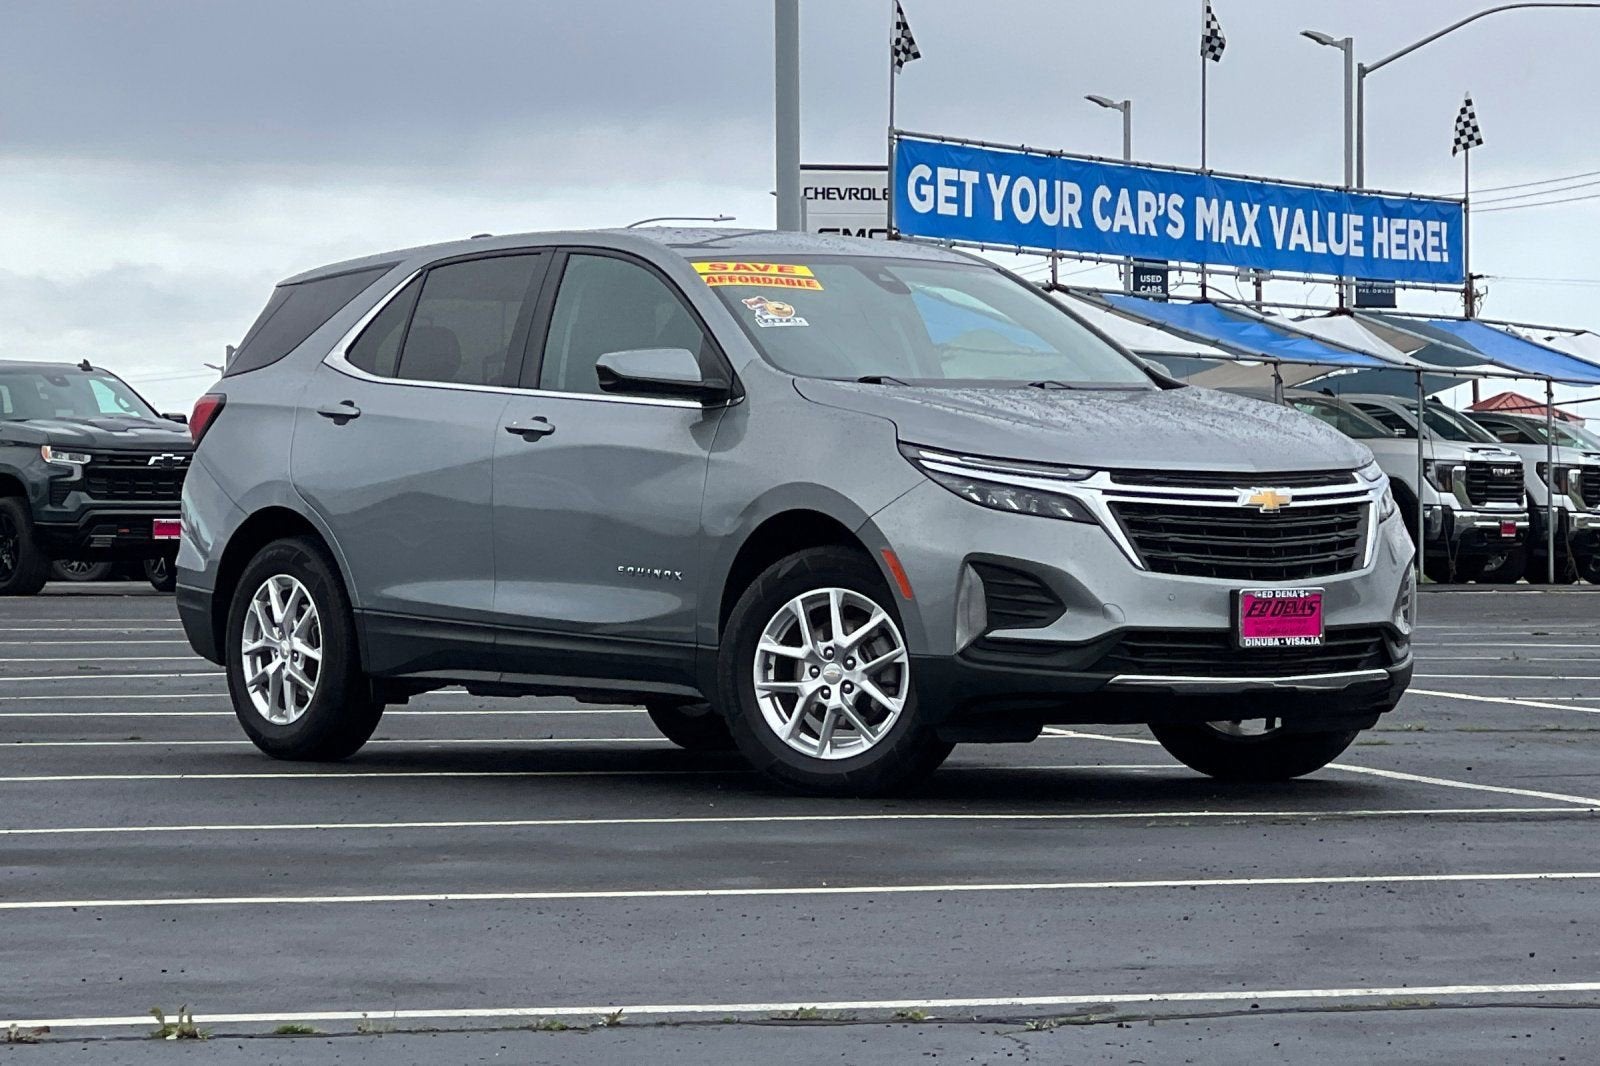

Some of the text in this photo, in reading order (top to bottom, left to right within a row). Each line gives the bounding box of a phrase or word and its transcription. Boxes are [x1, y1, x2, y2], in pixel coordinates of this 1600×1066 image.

[803, 187, 889, 201] CHEVROLE
[907, 163, 1449, 263] GET YOUR CAR'S MAX VALUE HERE!
[708, 263, 796, 274] SAVE
[706, 275, 817, 288] AFFORDABLE
[1140, 275, 1162, 283] USED
[1140, 285, 1163, 293] CARS
[1262, 590, 1305, 598] ED DENA'S
[1245, 600, 1272, 617] ED
[1245, 636, 1321, 647] DINUBA VISALIA
